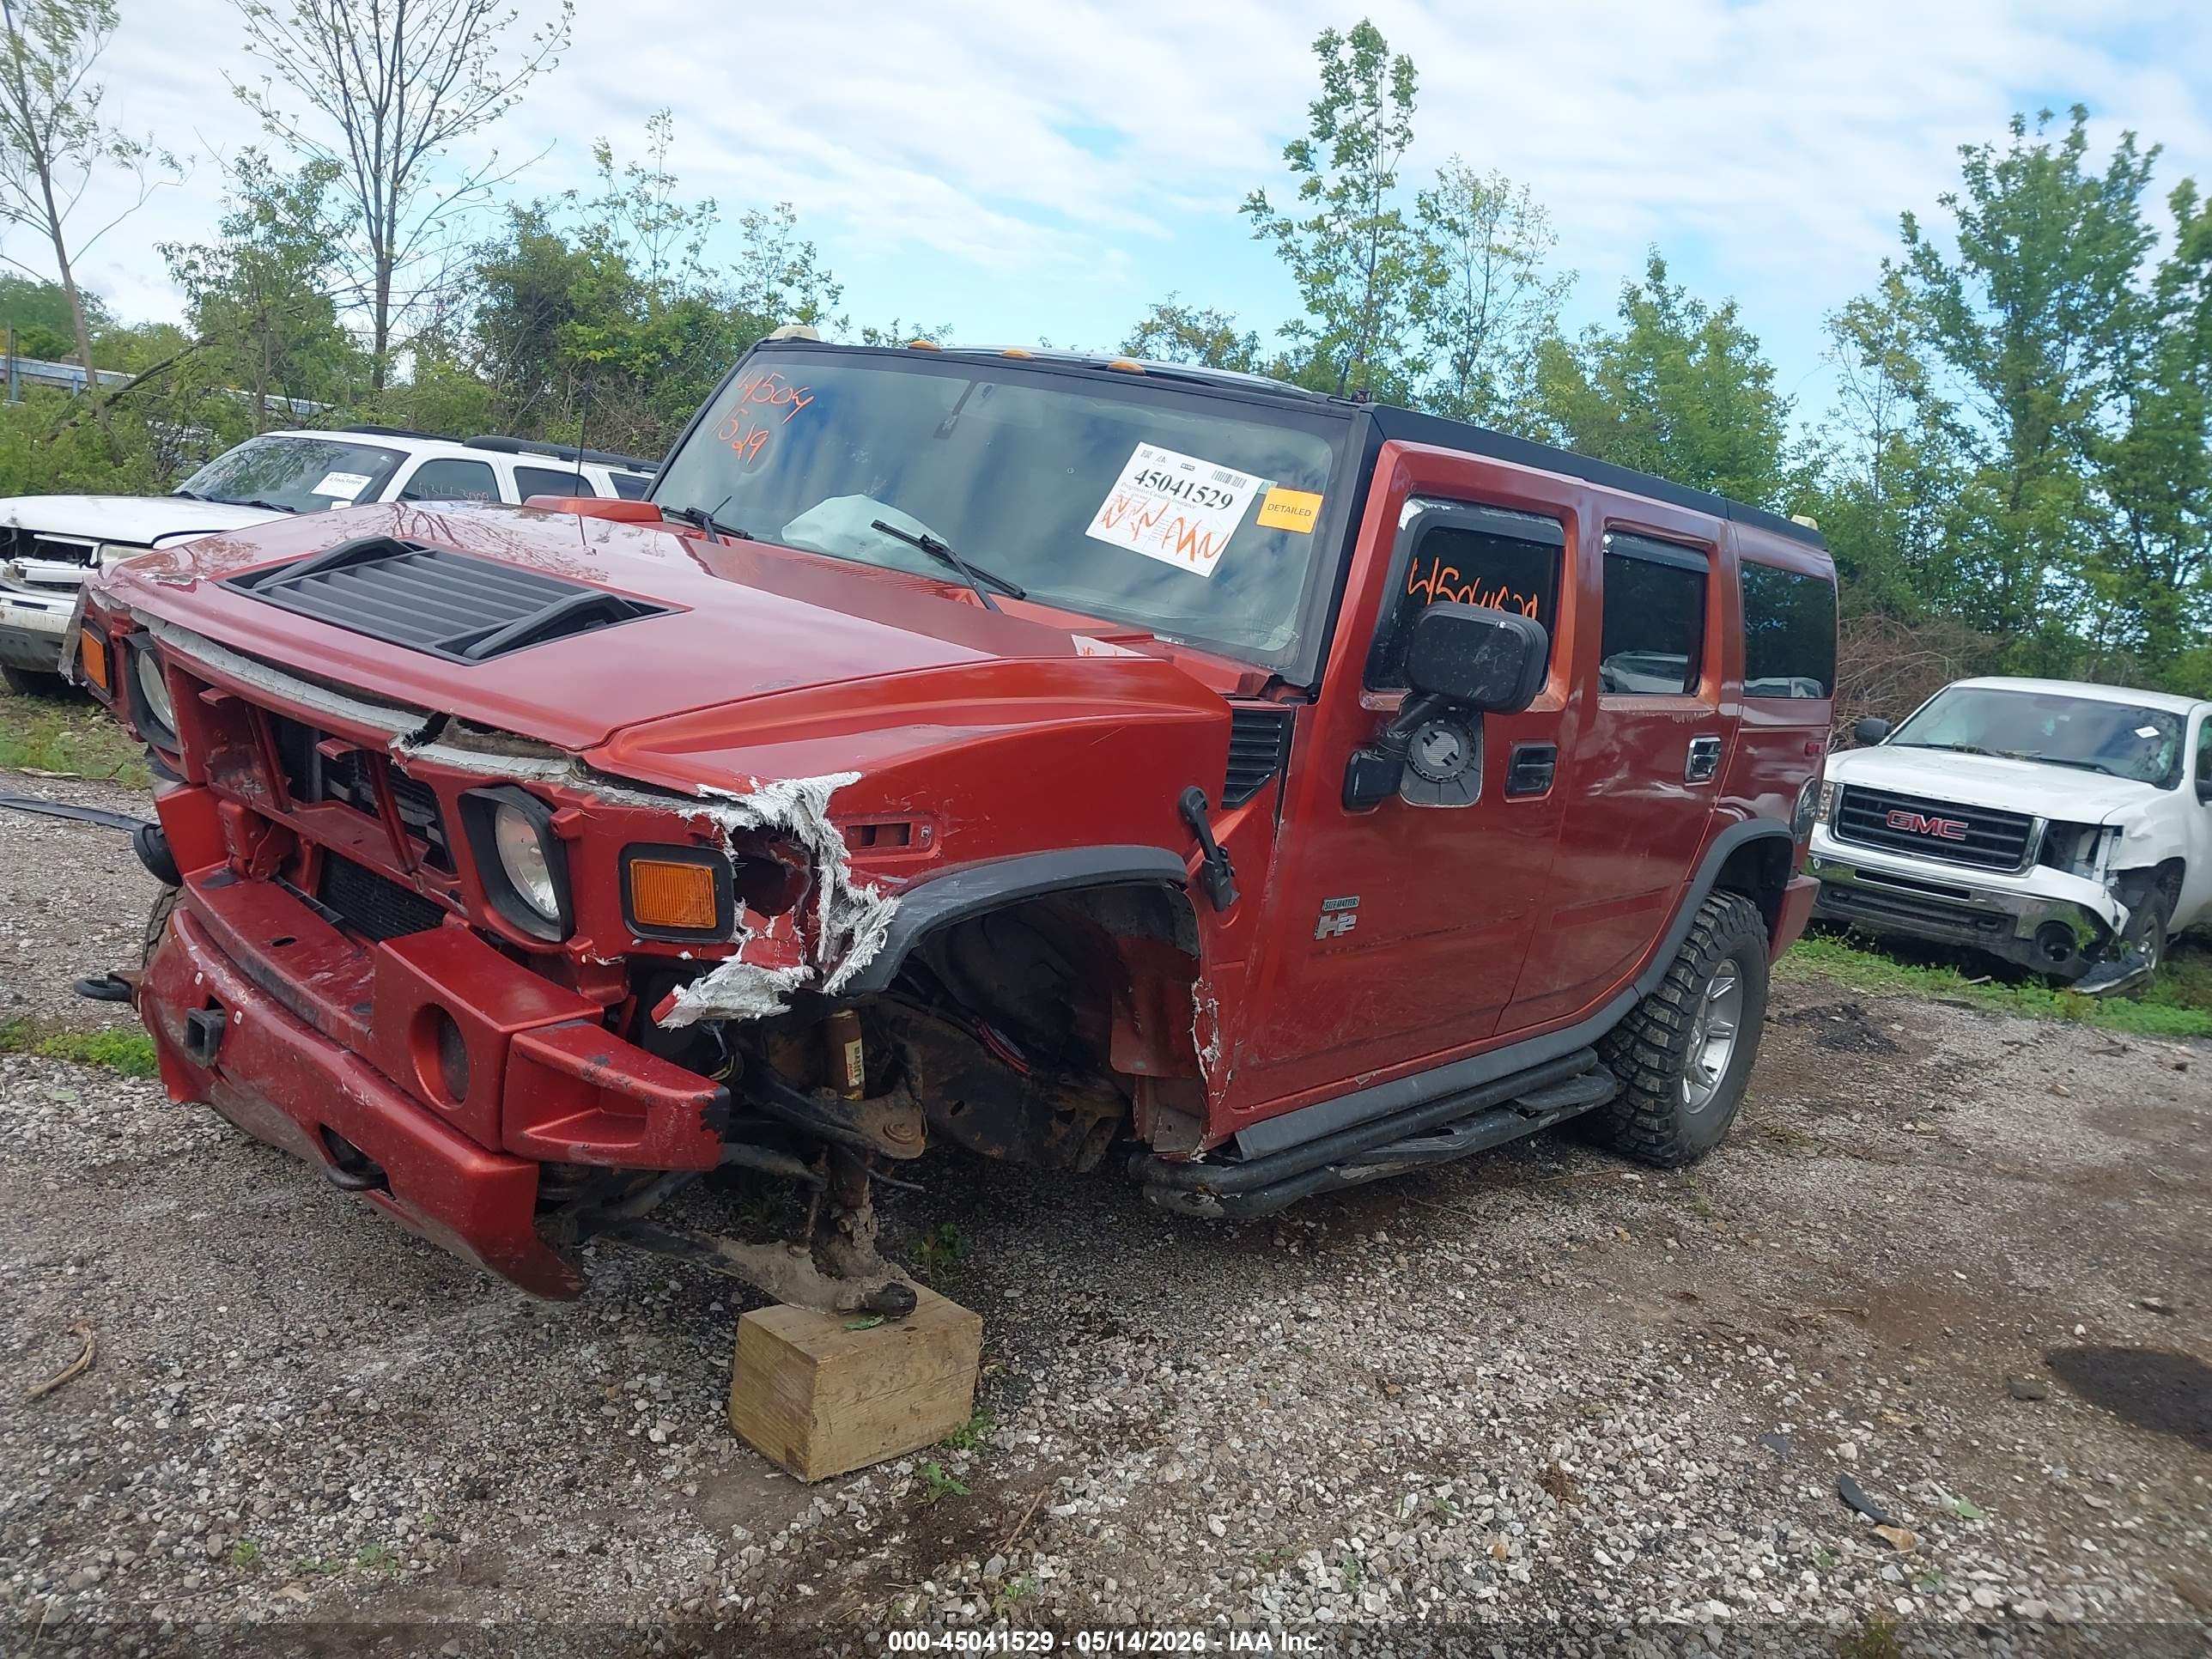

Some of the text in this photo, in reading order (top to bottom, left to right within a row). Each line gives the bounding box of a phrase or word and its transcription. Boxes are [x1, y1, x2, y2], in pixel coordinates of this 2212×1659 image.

[738, 371, 814, 425] 4504
[1134, 469, 1233, 510] 45041529
[1267, 503, 1311, 517] DETAILED
[1887, 810, 1968, 841] GMC
[1315, 912, 1357, 940] H2
